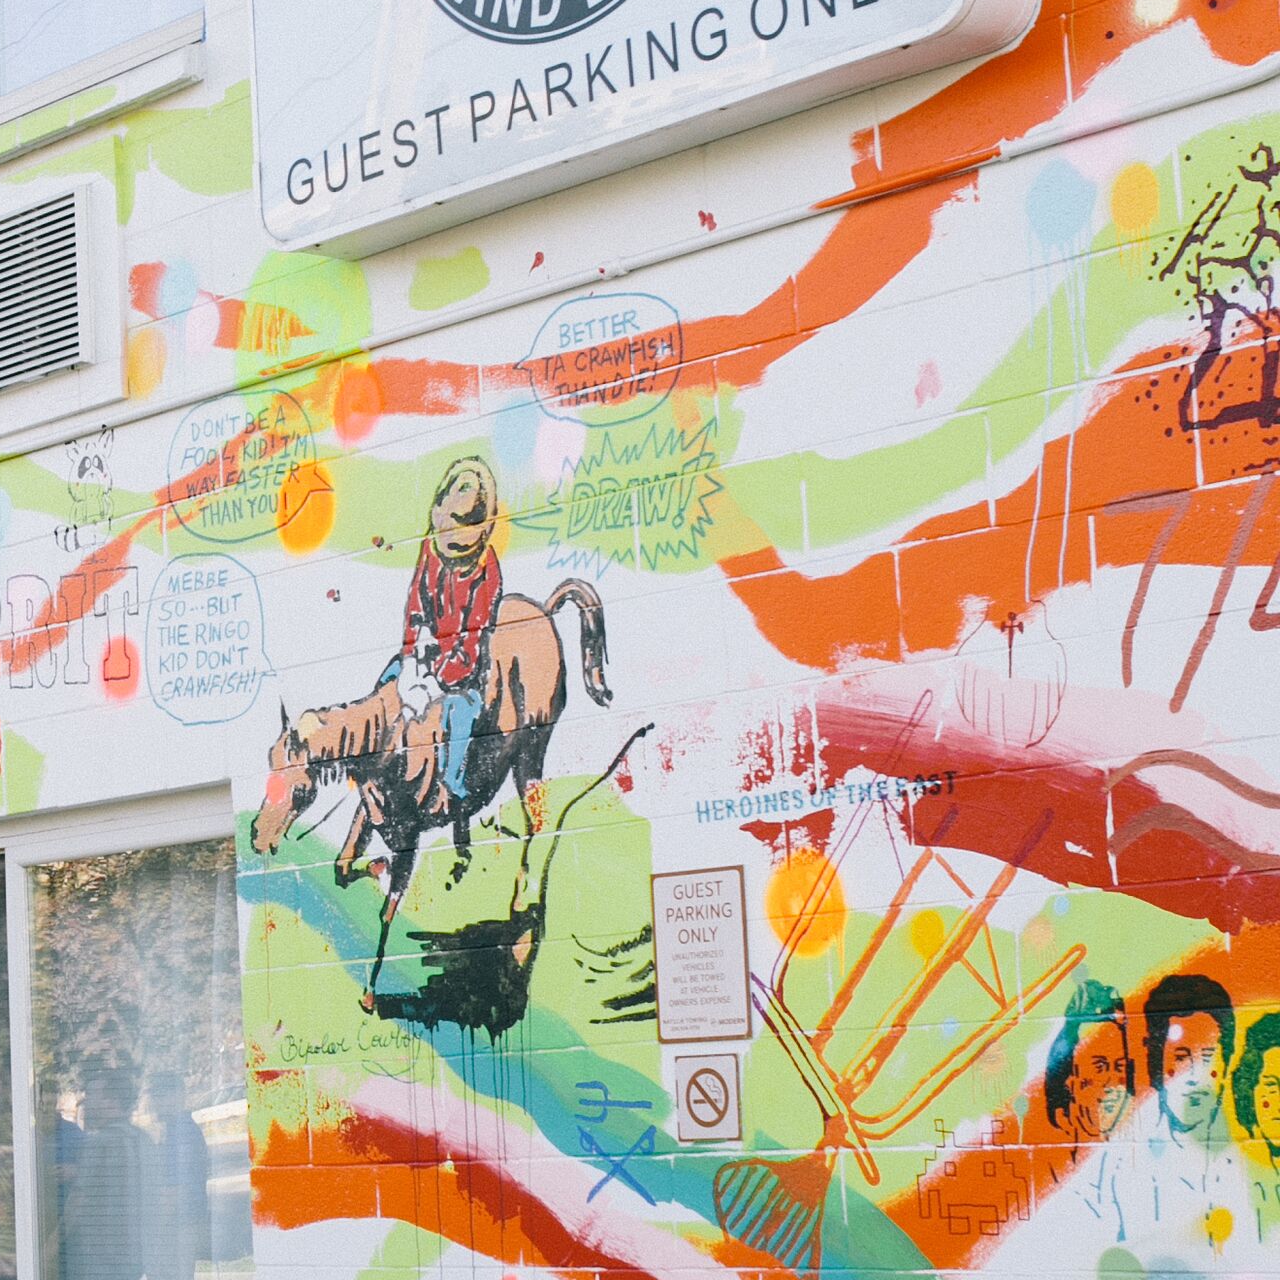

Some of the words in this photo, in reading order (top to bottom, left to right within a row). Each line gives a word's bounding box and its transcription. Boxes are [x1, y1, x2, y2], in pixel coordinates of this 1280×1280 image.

[286, 110, 450, 206] GUEST
[471, 7, 728, 144] PARKING
[559, 309, 639, 349] BETTER
[542, 354, 565, 381] TA
[574, 332, 674, 371] CRAWFISH
[555, 381, 606, 407] THAN
[609, 361, 660, 399] DIE!
[191, 413, 240, 441] DON'T
[245, 407, 270, 434] BE
[274, 405, 286, 429] A
[243, 434, 275, 462] KID!
[279, 430, 308, 459] I'M
[186, 474, 218, 499] WAY
[226, 461, 300, 495] FASTER
[567, 453, 716, 538] DRAW!
[200, 499, 243, 528] THAN
[247, 492, 288, 519] YOU!
[168, 570, 229, 594] MEBBE
[158, 624, 190, 647] THE
[195, 620, 250, 645] RINGO
[159, 651, 188, 675] KID
[196, 644, 249, 669] DON'T
[161, 666, 256, 701] CRAWFISH!
[696, 789, 804, 824] HEROINES
[810, 786, 837, 808] OF
[844, 780, 887, 804] THE
[896, 770, 958, 797] EAST
[673, 880, 723, 901] GUEST
[666, 902, 733, 923] PARKING
[678, 926, 719, 945] ONLY
[682, 962, 715, 972] VEHICLES
[280, 1034, 350, 1064] Bipolar
[356, 1020, 423, 1072] Cowboy
